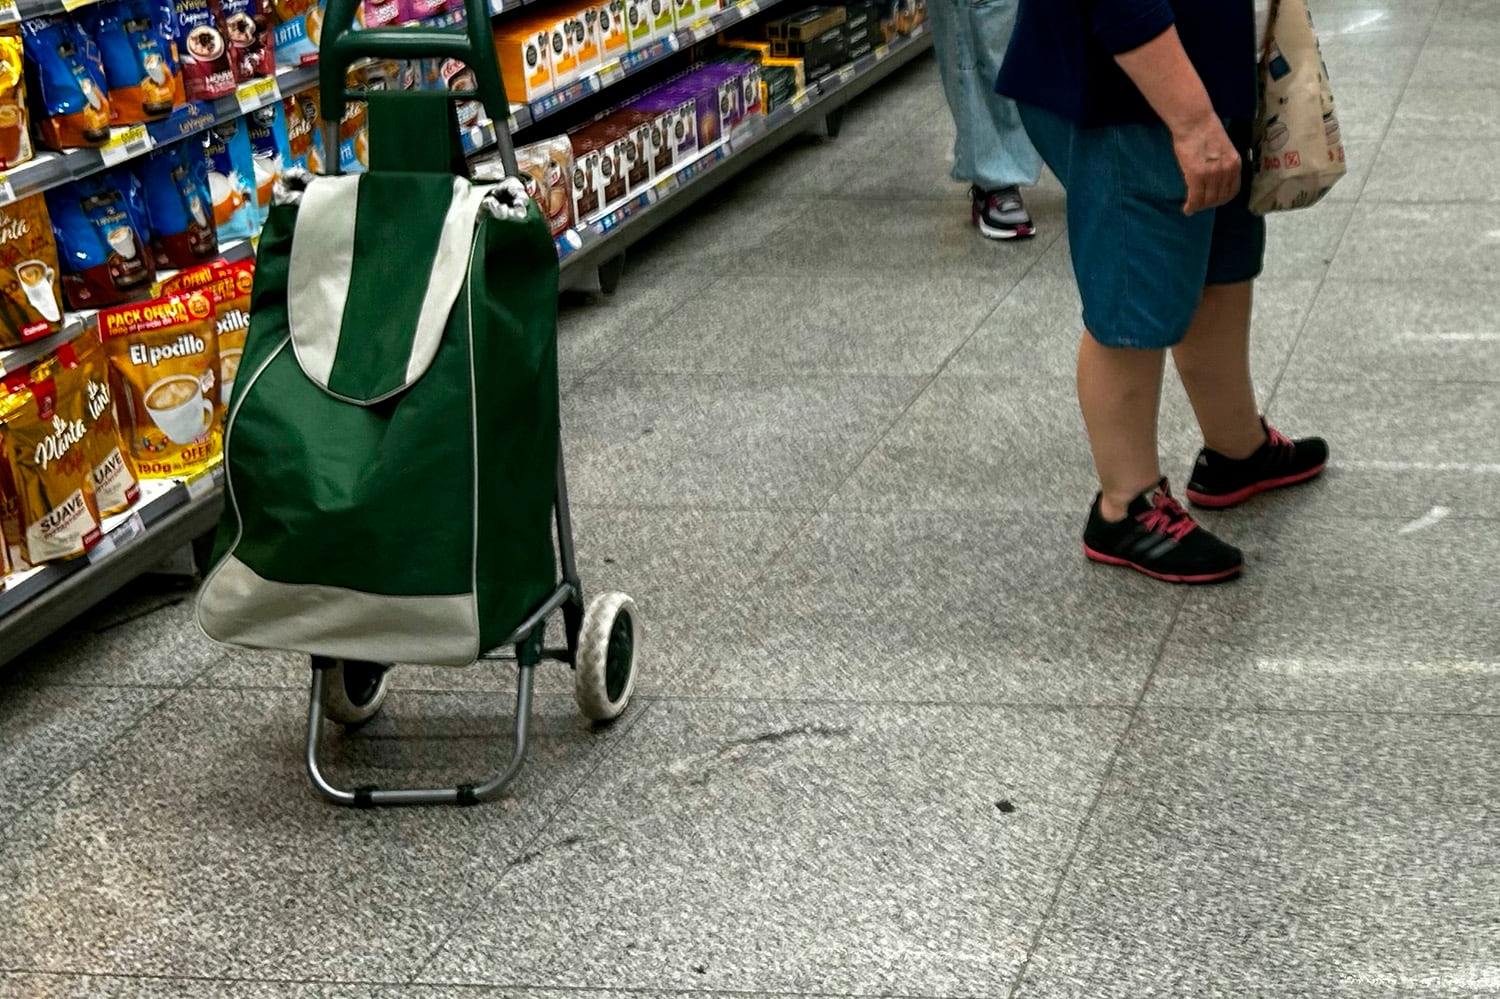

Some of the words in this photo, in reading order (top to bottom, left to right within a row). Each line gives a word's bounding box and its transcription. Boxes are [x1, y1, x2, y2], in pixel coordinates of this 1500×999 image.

[275, 22, 303, 44] LATTE
[179, 114, 215, 133] LaVirginia
[107, 307, 142, 329] PACK
[144, 301, 187, 321] OFERTA
[130, 344, 147, 366] El
[149, 334, 205, 368] pocillo
[53, 413, 68, 436] La
[34, 418, 88, 470] Planta
[180, 443, 214, 463] OFER
[93, 453, 123, 486] UAVE
[40, 494, 84, 533] SUAVE
